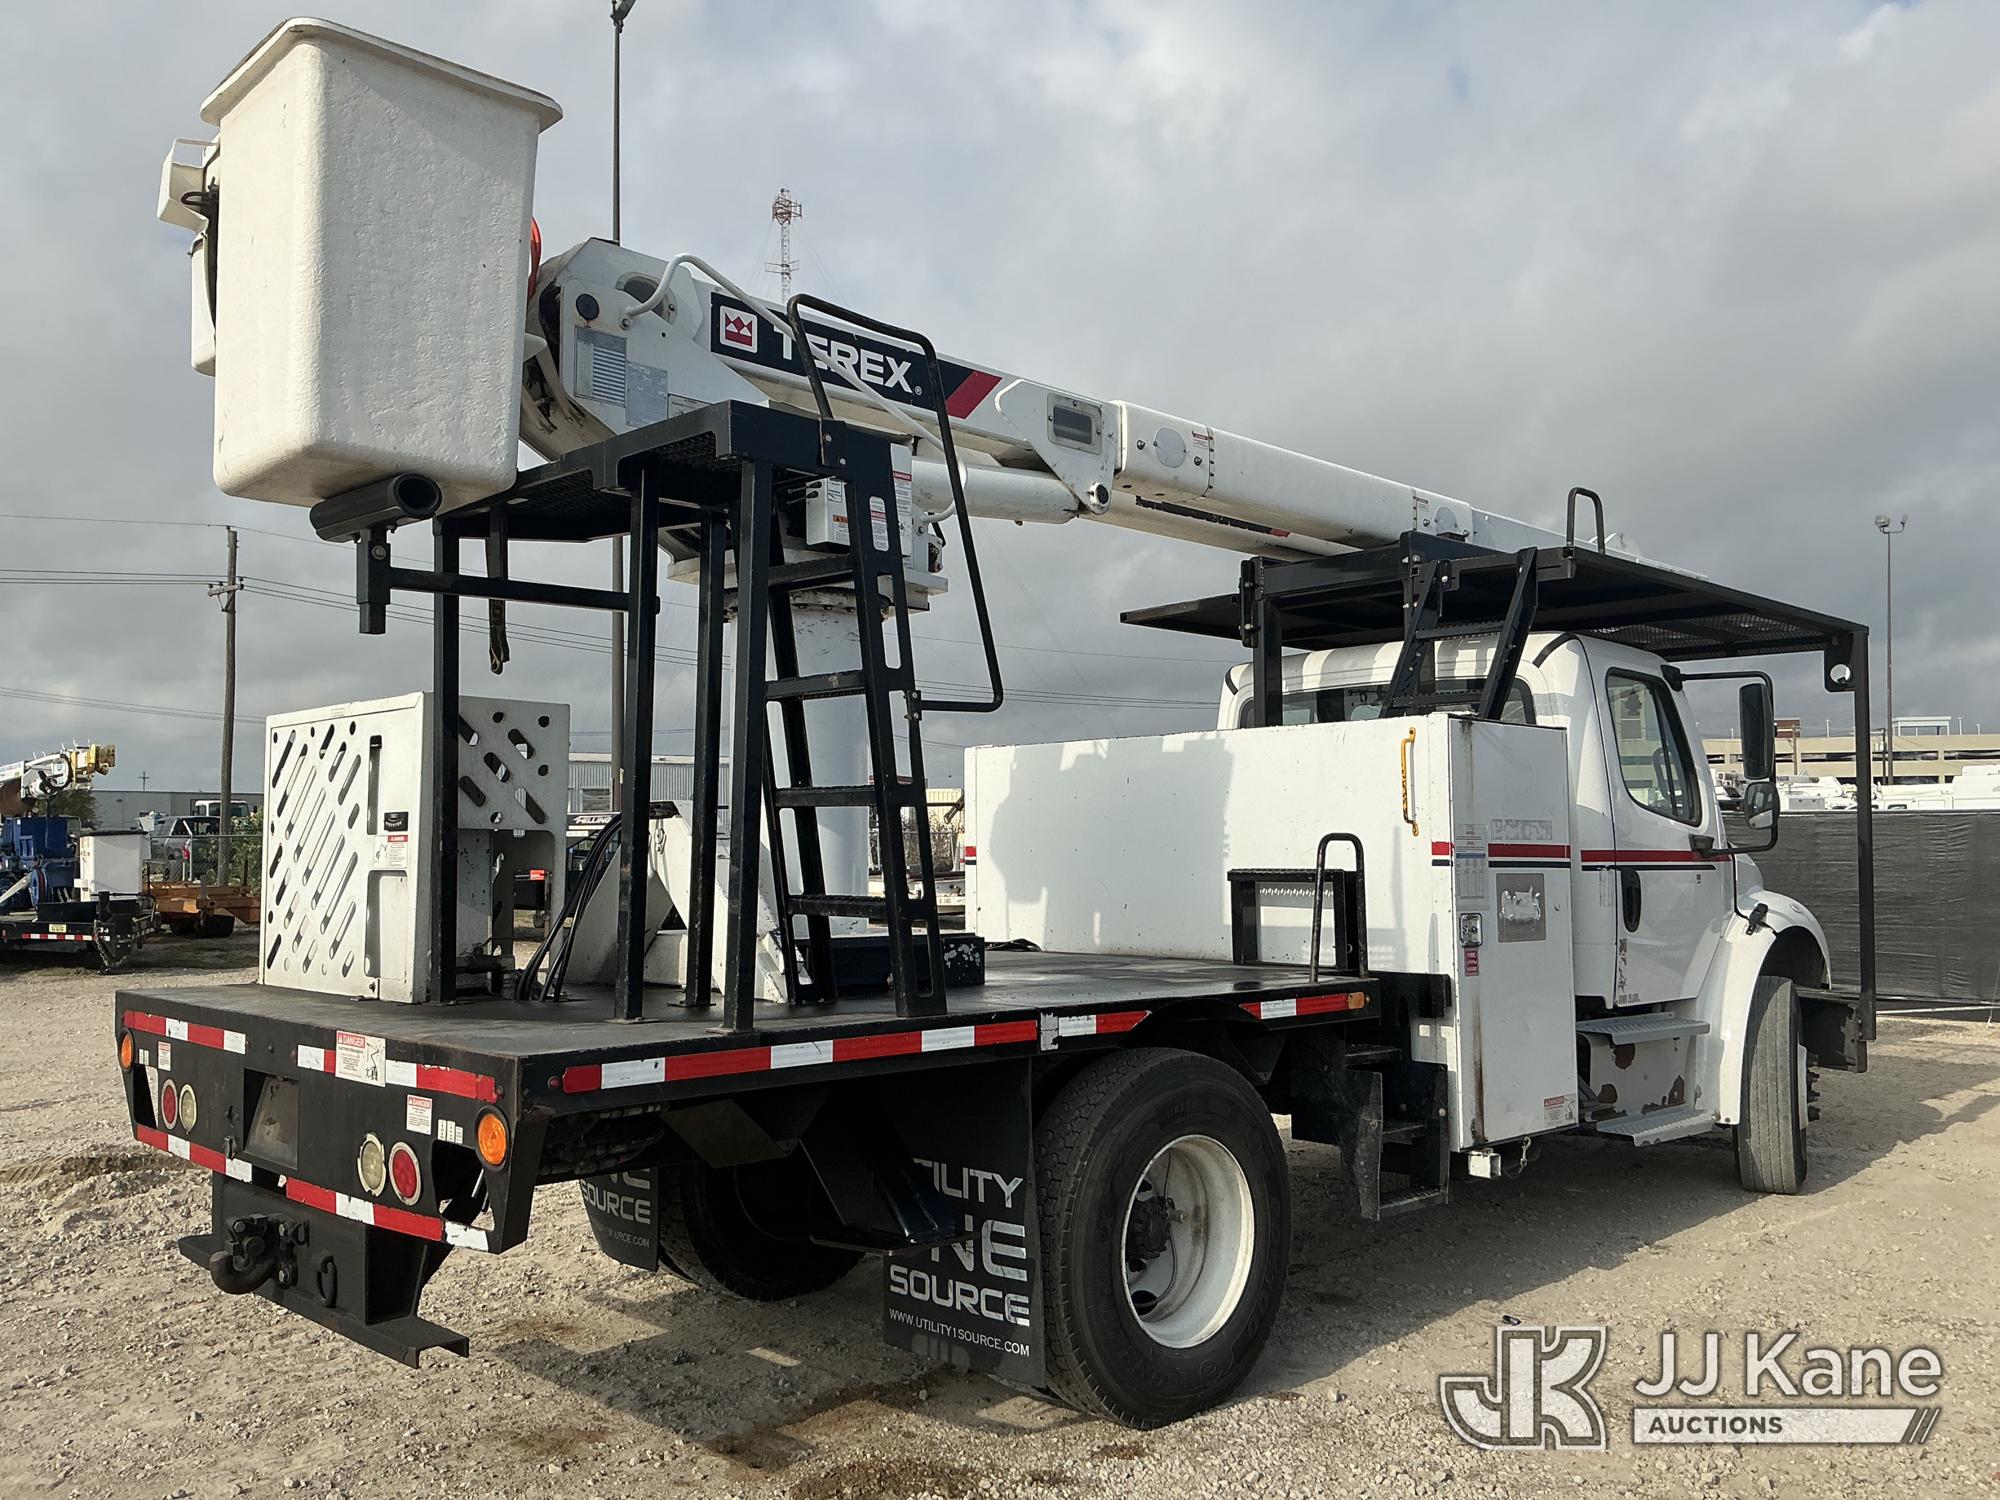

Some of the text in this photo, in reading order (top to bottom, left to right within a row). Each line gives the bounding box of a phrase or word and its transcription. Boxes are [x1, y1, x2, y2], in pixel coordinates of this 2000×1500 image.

[580, 1178, 651, 1224] SOURCE
[889, 1264, 1031, 1327] SOURCE
[888, 1308, 1030, 1357] WWW.UTILITY1SOURCE.COM
